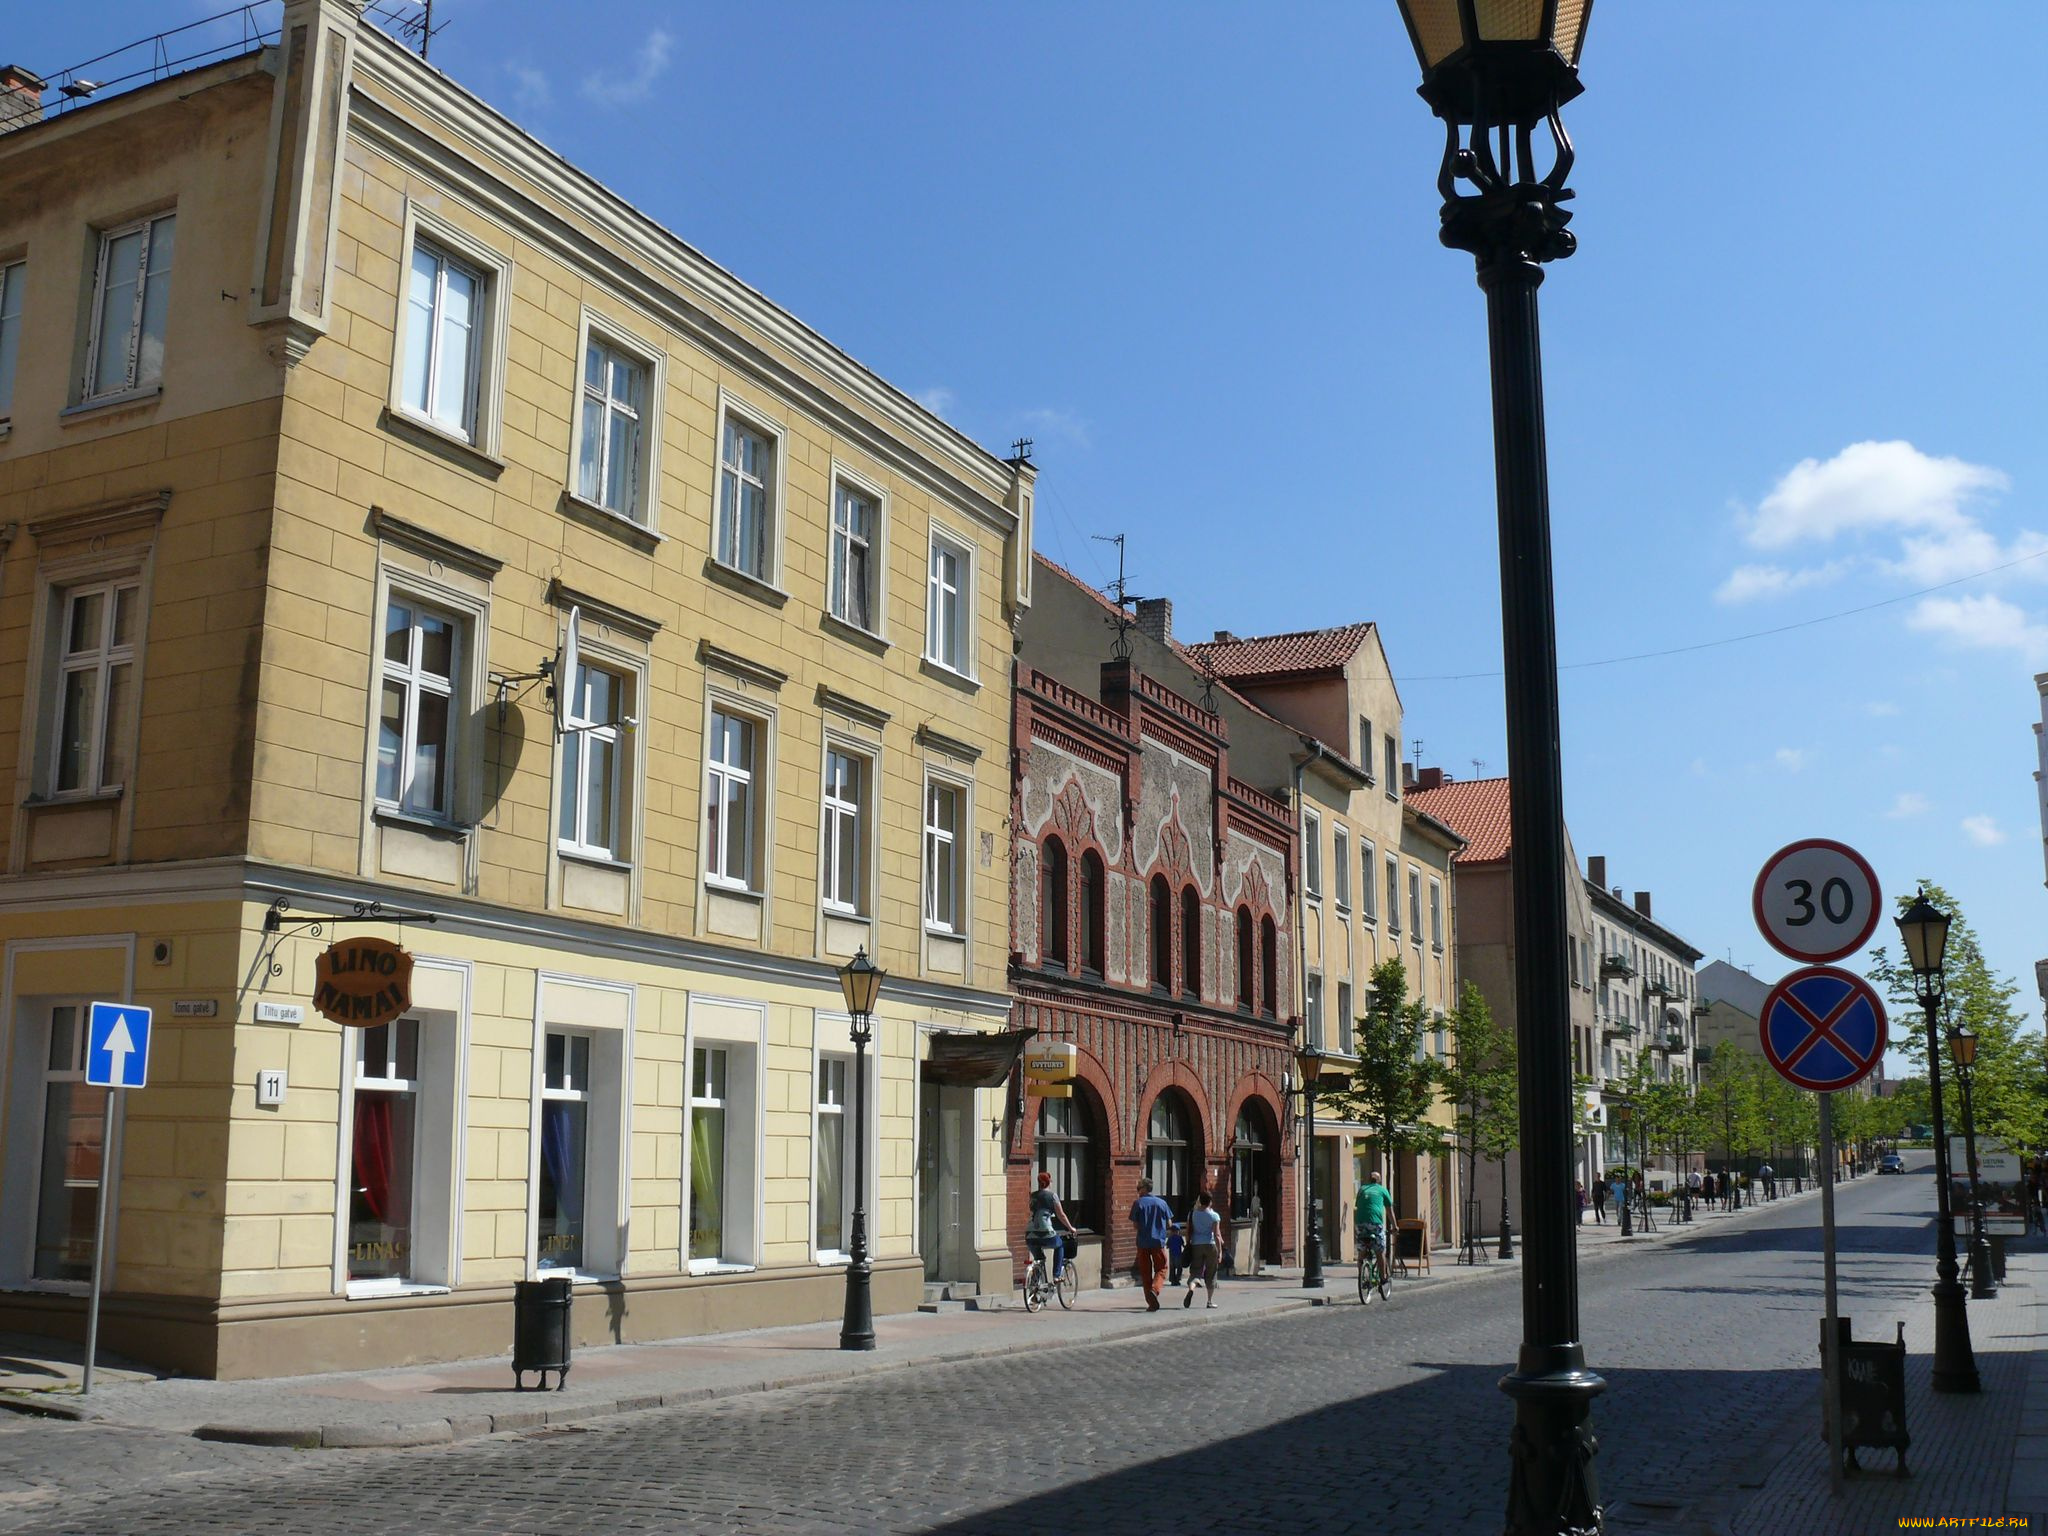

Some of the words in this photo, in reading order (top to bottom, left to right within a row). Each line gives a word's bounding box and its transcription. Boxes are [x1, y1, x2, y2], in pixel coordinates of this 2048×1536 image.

[1784, 877, 1853, 926] 30
[329, 948, 397, 977] LINO
[319, 981, 404, 1020] NAMAI
[267, 1077, 279, 1097] 11
